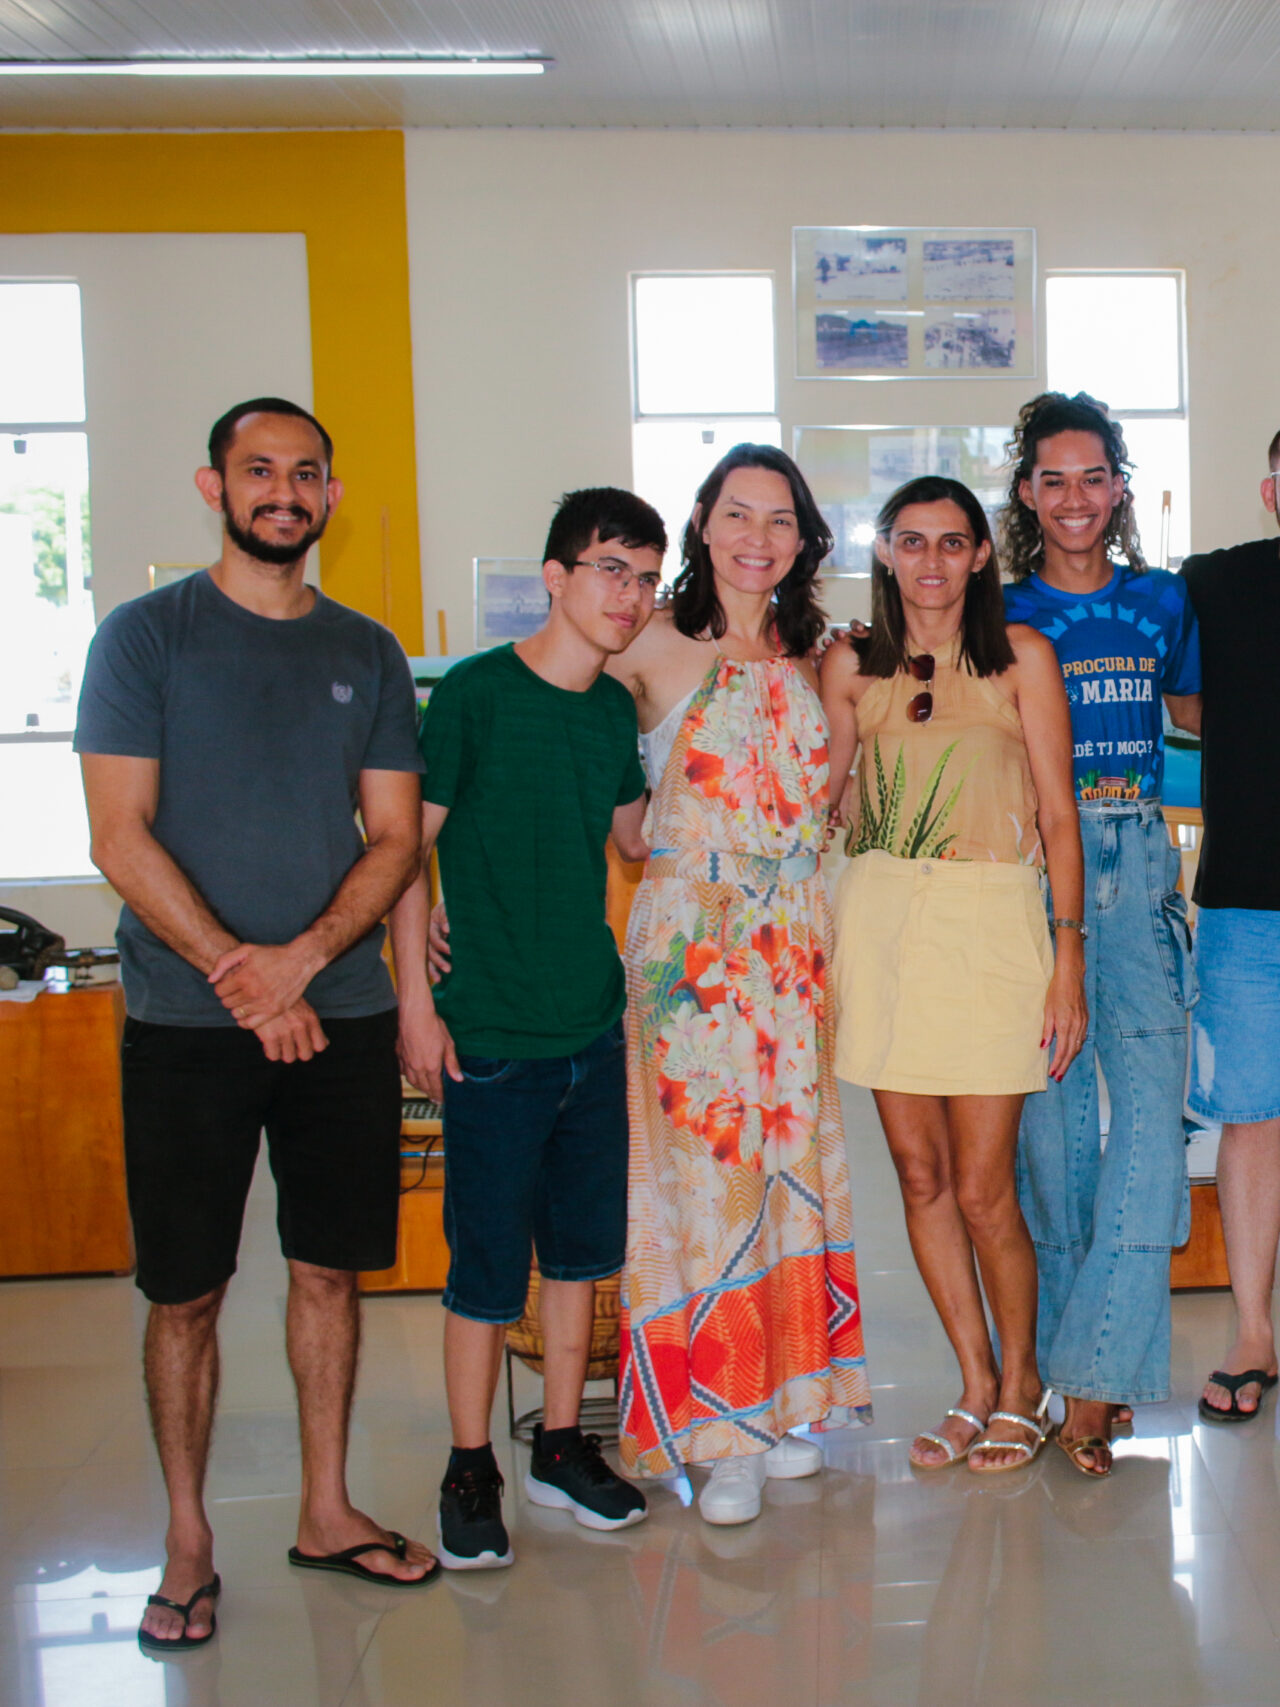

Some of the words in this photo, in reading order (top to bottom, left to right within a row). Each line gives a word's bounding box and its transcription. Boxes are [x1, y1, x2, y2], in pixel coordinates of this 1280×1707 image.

[1062, 656, 1136, 678] PROCURA
[1139, 657, 1156, 673] DE
[1081, 678, 1153, 705] MARIA
[1073, 740, 1095, 758] DÊ
